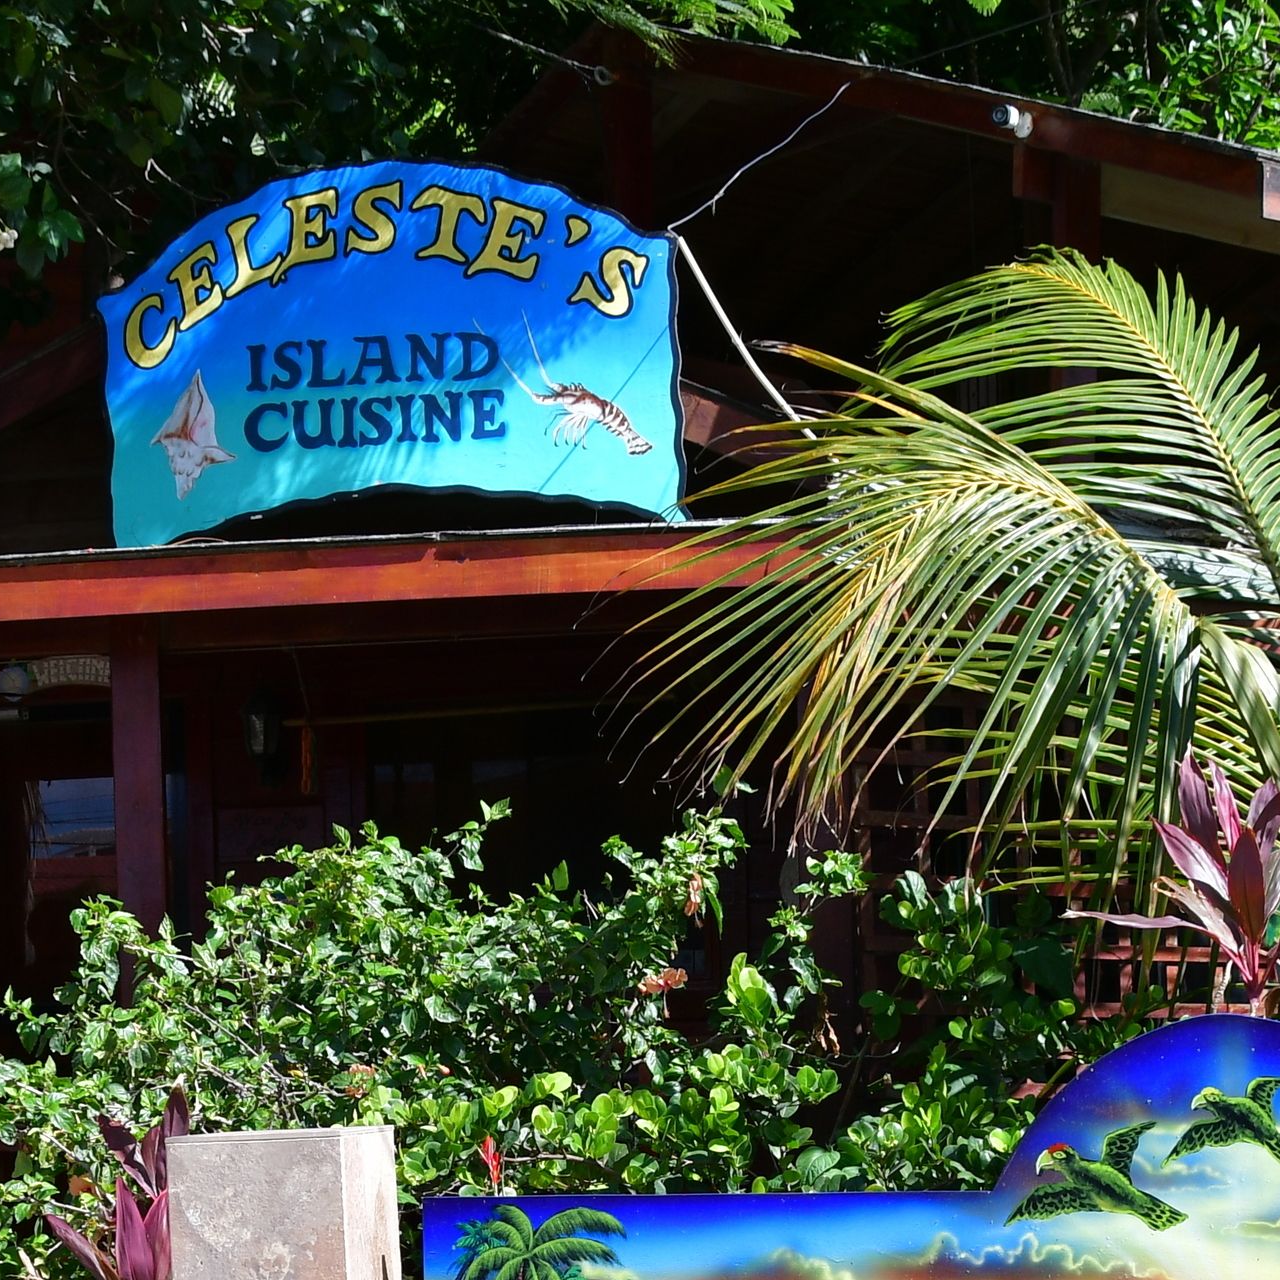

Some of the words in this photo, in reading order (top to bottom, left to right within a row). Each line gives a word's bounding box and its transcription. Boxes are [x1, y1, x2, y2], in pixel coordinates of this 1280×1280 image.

[123, 180, 649, 370] CELESTE'S
[245, 331, 499, 392] ISLAND
[243, 388, 505, 453] CUISINE
